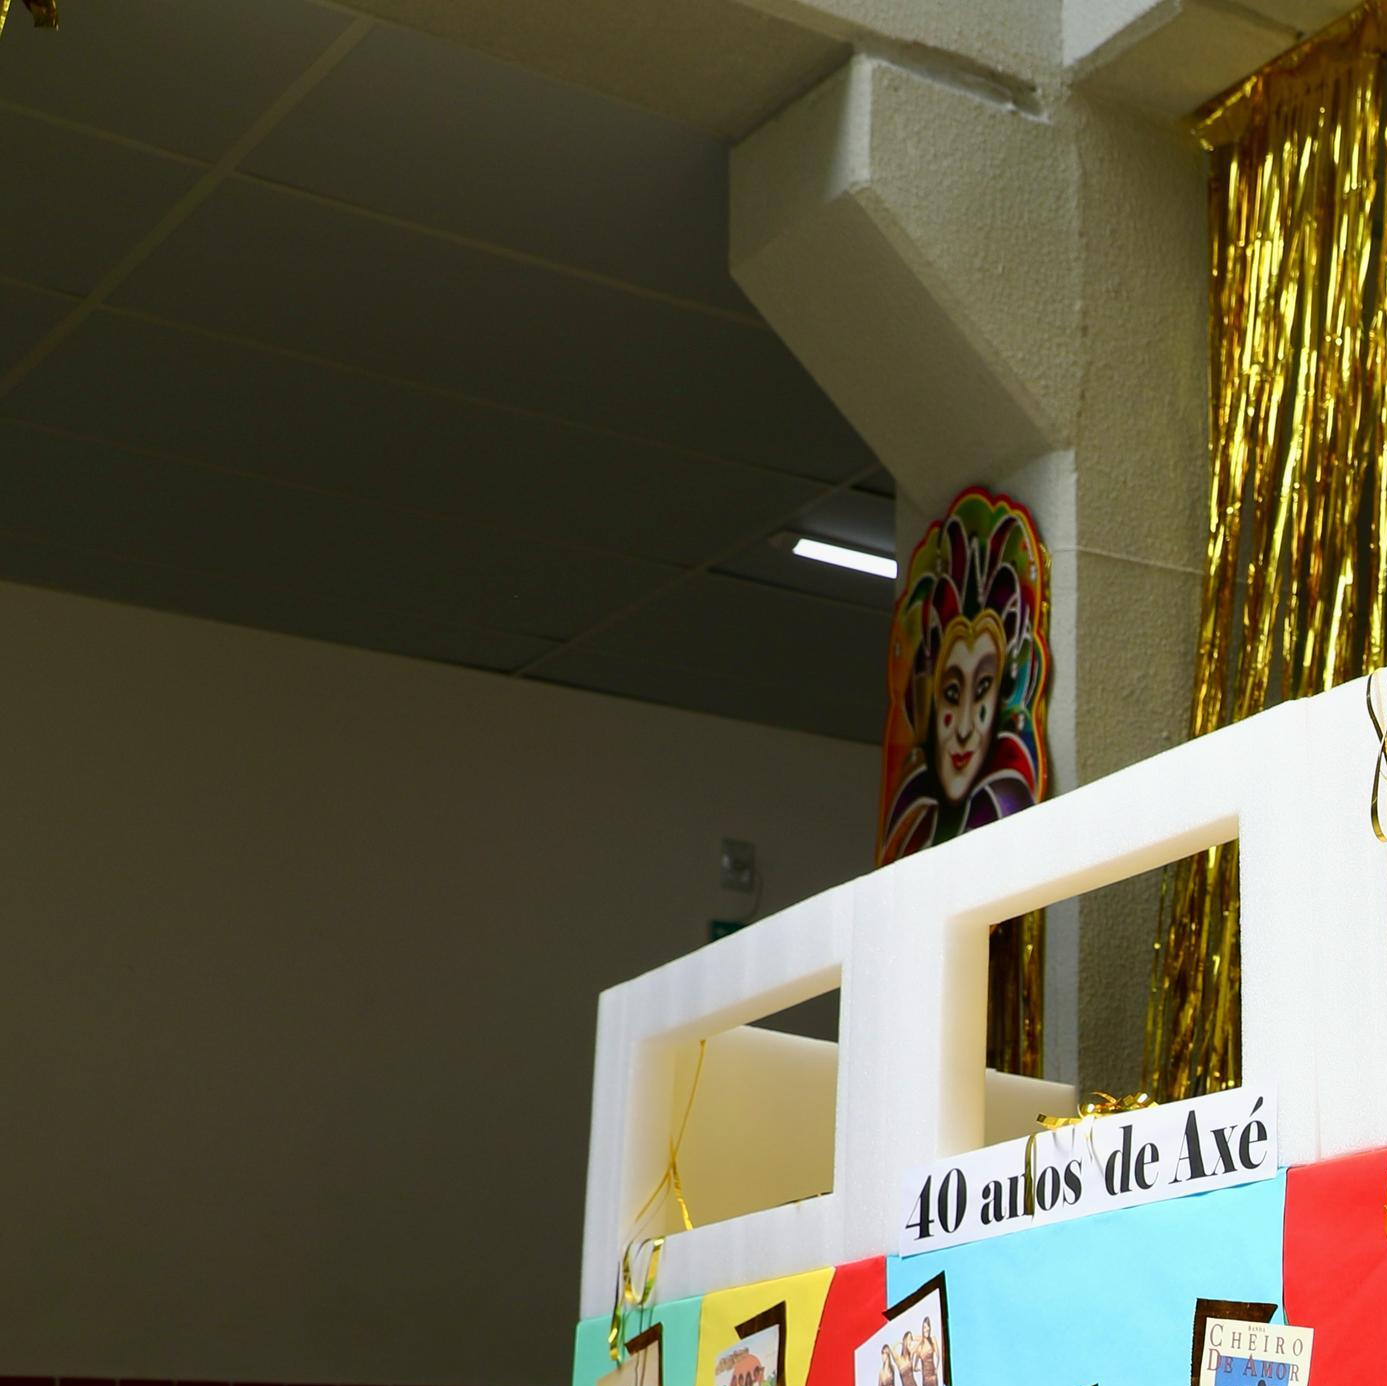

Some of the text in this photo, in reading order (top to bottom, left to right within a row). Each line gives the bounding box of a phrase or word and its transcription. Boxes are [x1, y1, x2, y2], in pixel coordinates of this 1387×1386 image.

[906, 1096, 1268, 1240] 40 anos de Axé
